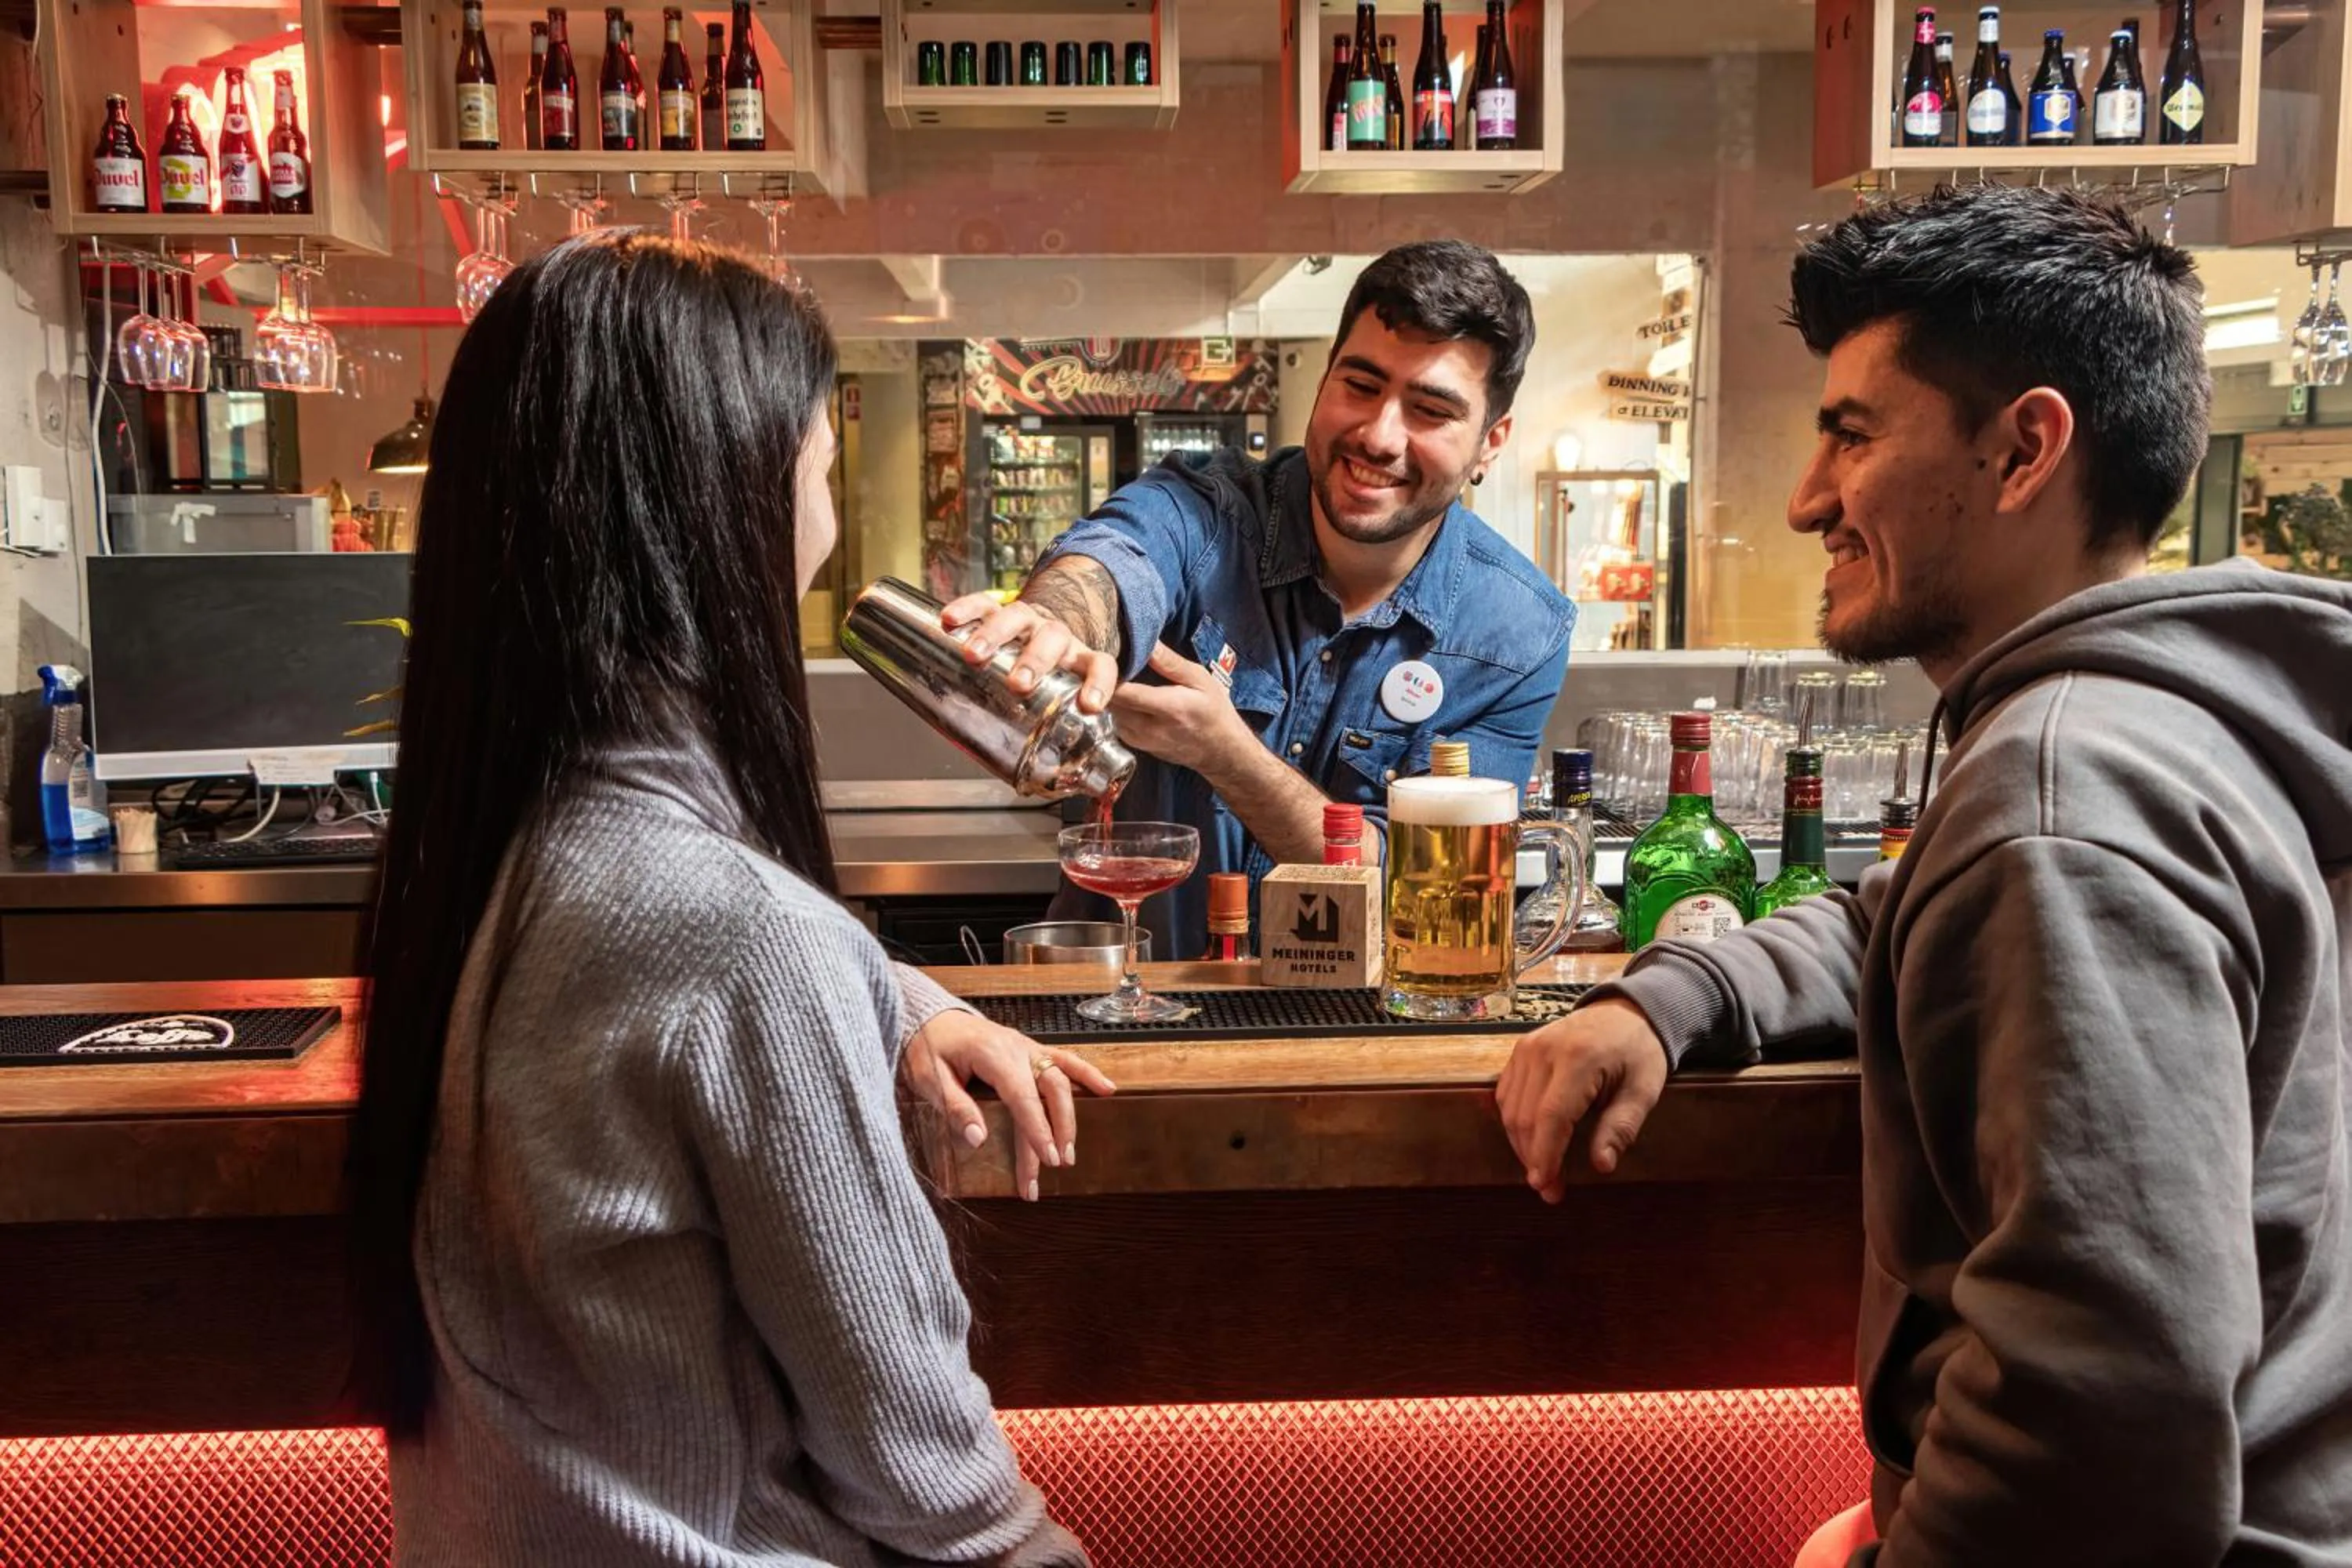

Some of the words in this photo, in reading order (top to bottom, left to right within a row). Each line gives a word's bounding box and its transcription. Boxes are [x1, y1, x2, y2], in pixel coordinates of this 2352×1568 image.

[1607, 375, 1679, 397] DINNING
[1272, 948, 1356, 962] MEININGER
[1291, 964, 1337, 974] HOTELS
